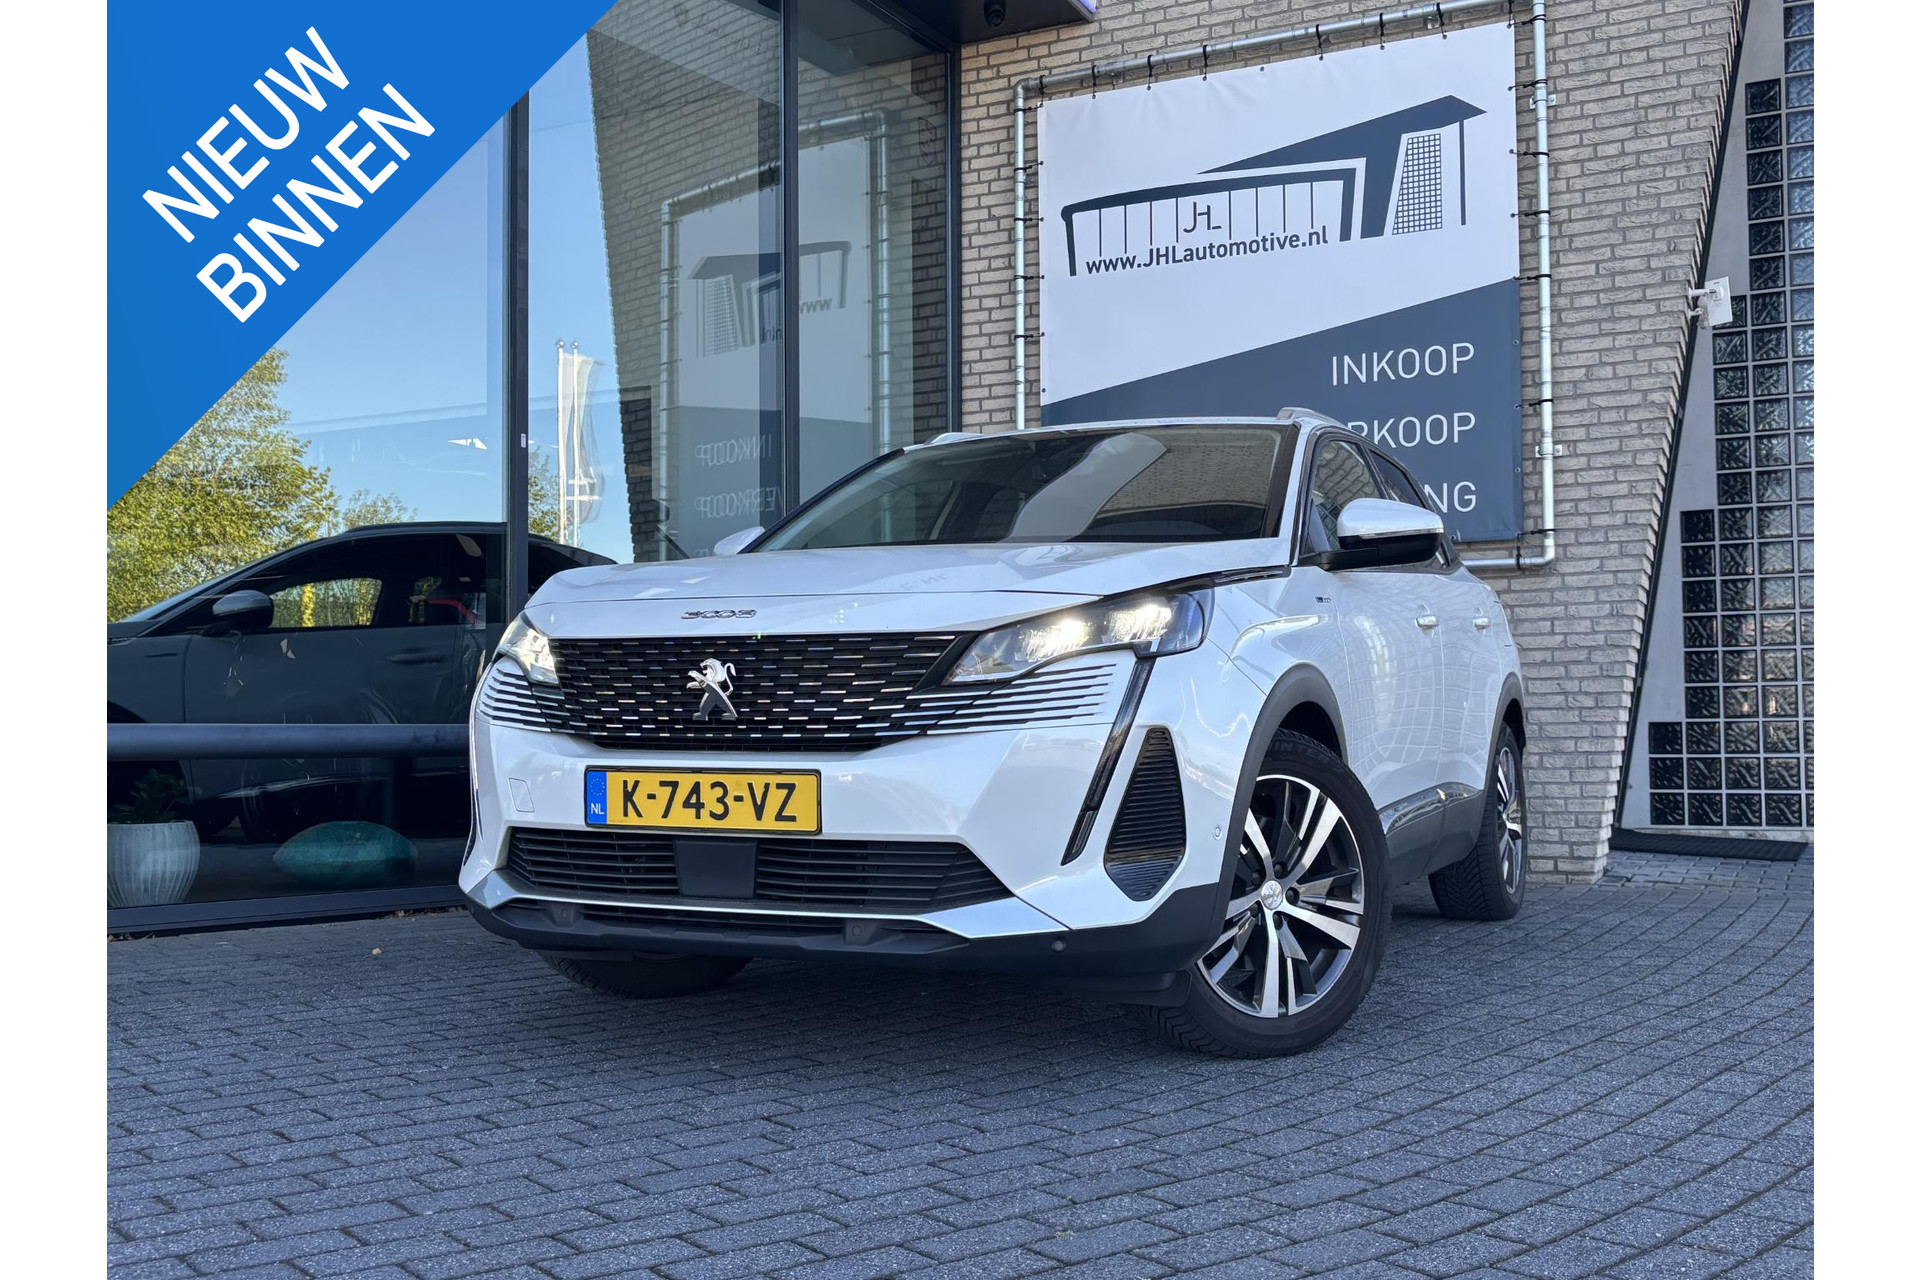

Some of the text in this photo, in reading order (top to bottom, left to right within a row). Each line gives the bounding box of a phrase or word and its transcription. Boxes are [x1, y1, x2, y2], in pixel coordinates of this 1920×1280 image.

[1086, 225, 1328, 274] www.JHLautomotive.nl
[1332, 342, 1475, 386] INKOOP
[590, 803, 605, 815] NL
[622, 780, 797, 822] K-743-VZ
